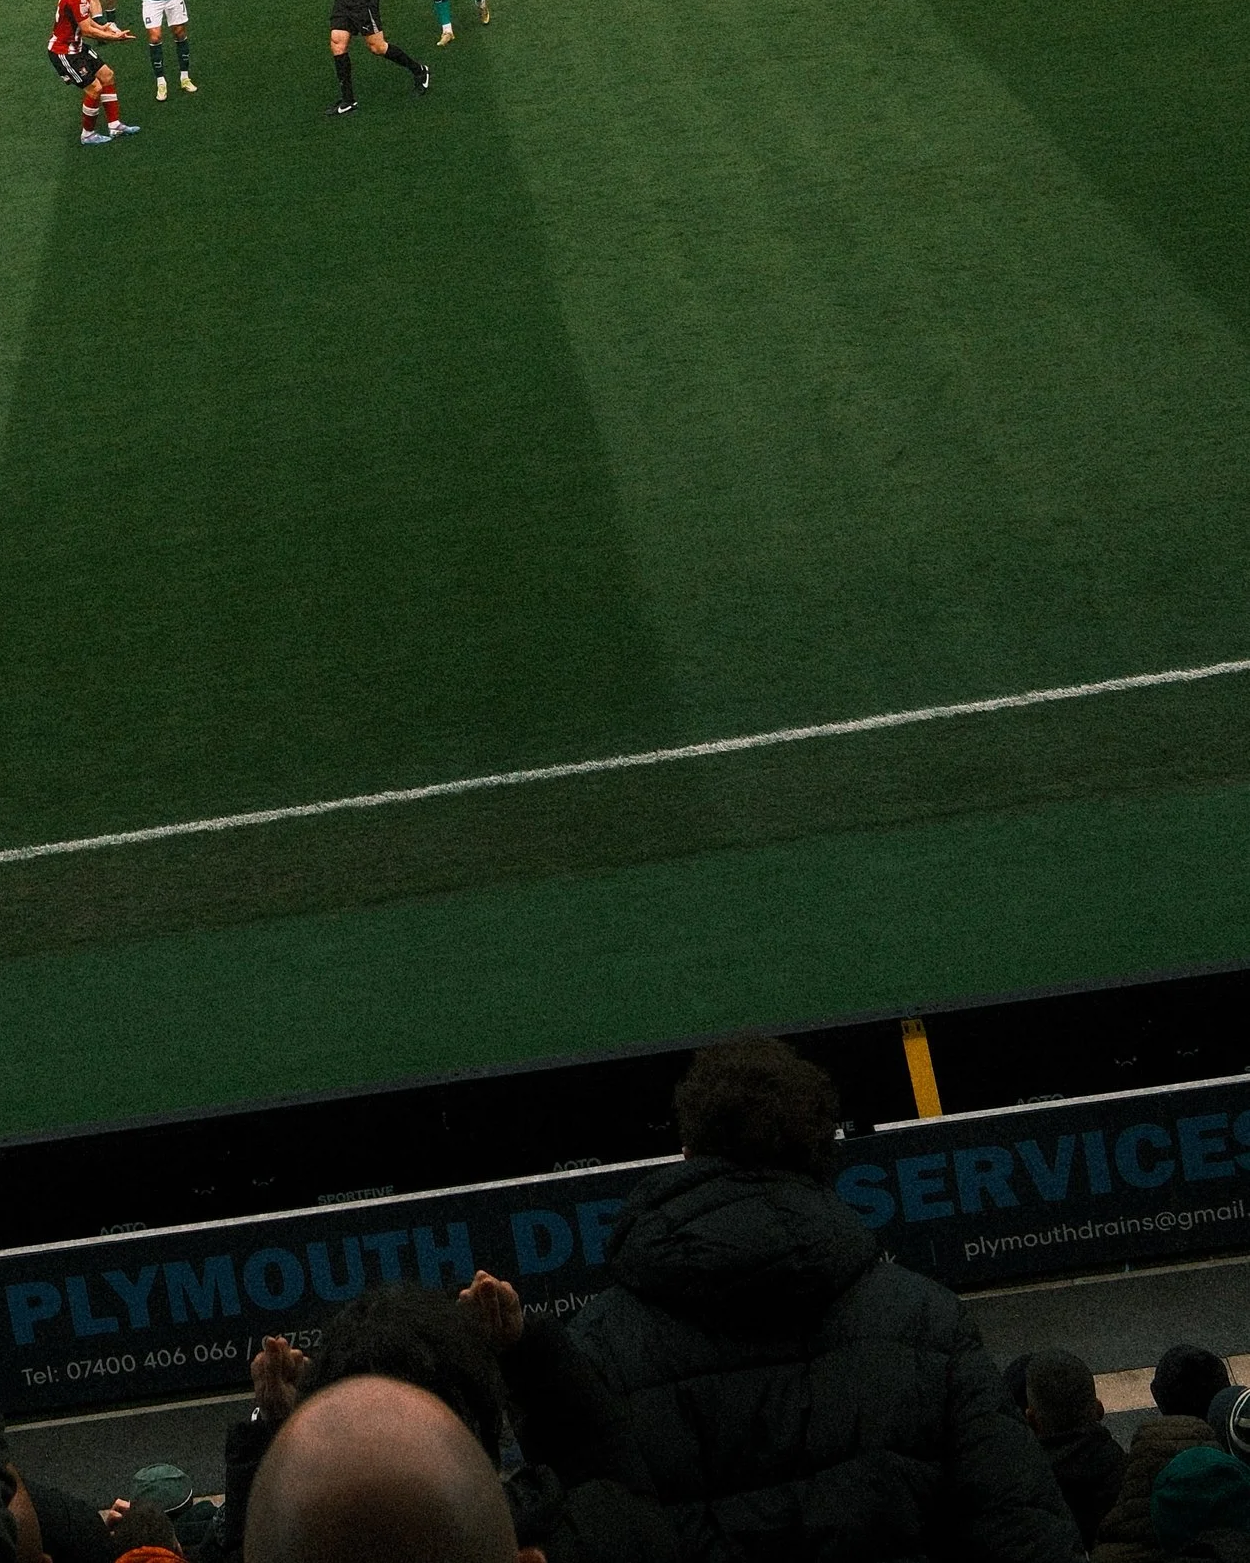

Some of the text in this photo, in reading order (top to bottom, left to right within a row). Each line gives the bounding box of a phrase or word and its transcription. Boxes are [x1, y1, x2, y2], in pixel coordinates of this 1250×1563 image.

[317, 1184, 396, 1206] SPORTFIVE
[834, 1109, 1250, 1230] SERVICE
[5, 1218, 475, 1346] PLYMOUTH
[21, 1366, 60, 1386] Tel:
[66, 1353, 137, 1381] 07400
[143, 1347, 188, 1369] 406
[193, 1340, 238, 1363] 066
